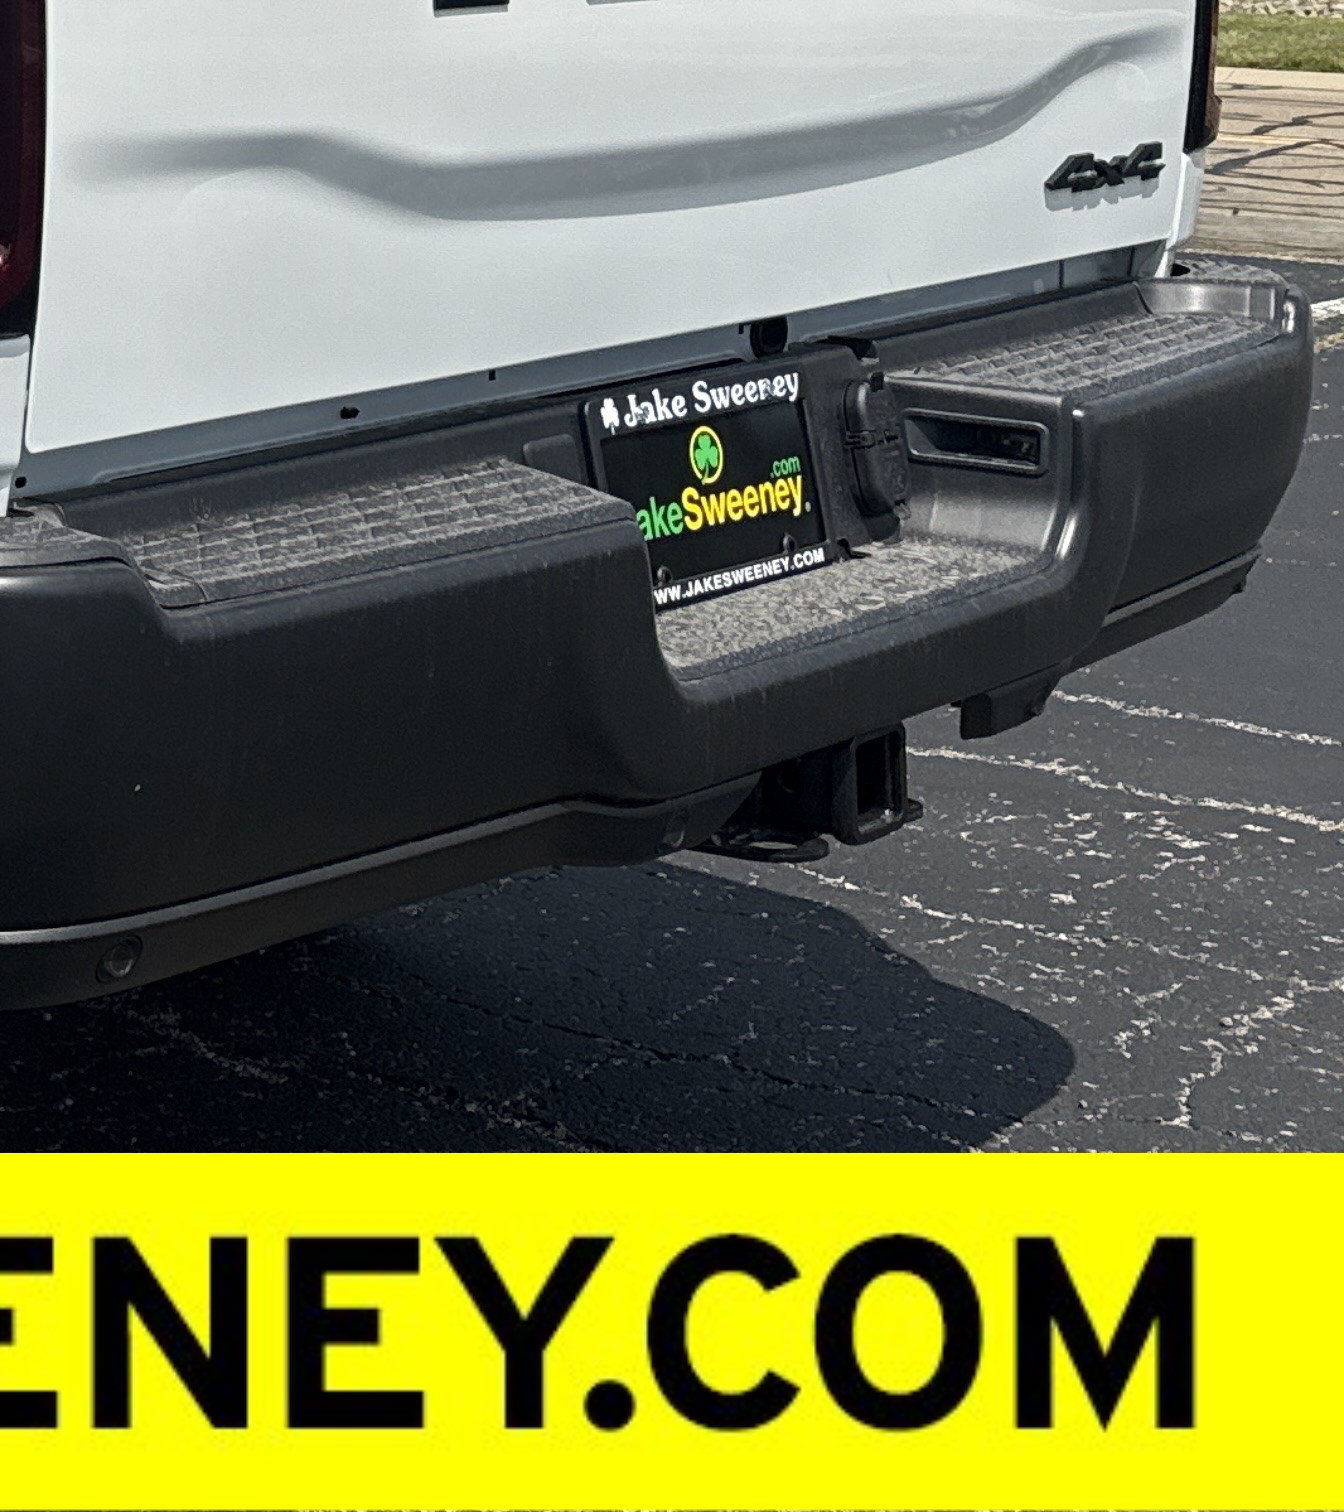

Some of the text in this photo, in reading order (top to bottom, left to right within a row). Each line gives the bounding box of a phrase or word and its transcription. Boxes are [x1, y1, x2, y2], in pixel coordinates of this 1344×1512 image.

[1044, 140, 1165, 193] 4x4
[624, 372, 799, 428] Jake Sweeney
[770, 455, 800, 479] .com
[636, 474, 802, 542] akeSweeney
[653, 548, 824, 605] WW.JAKESWEENEY.COM
